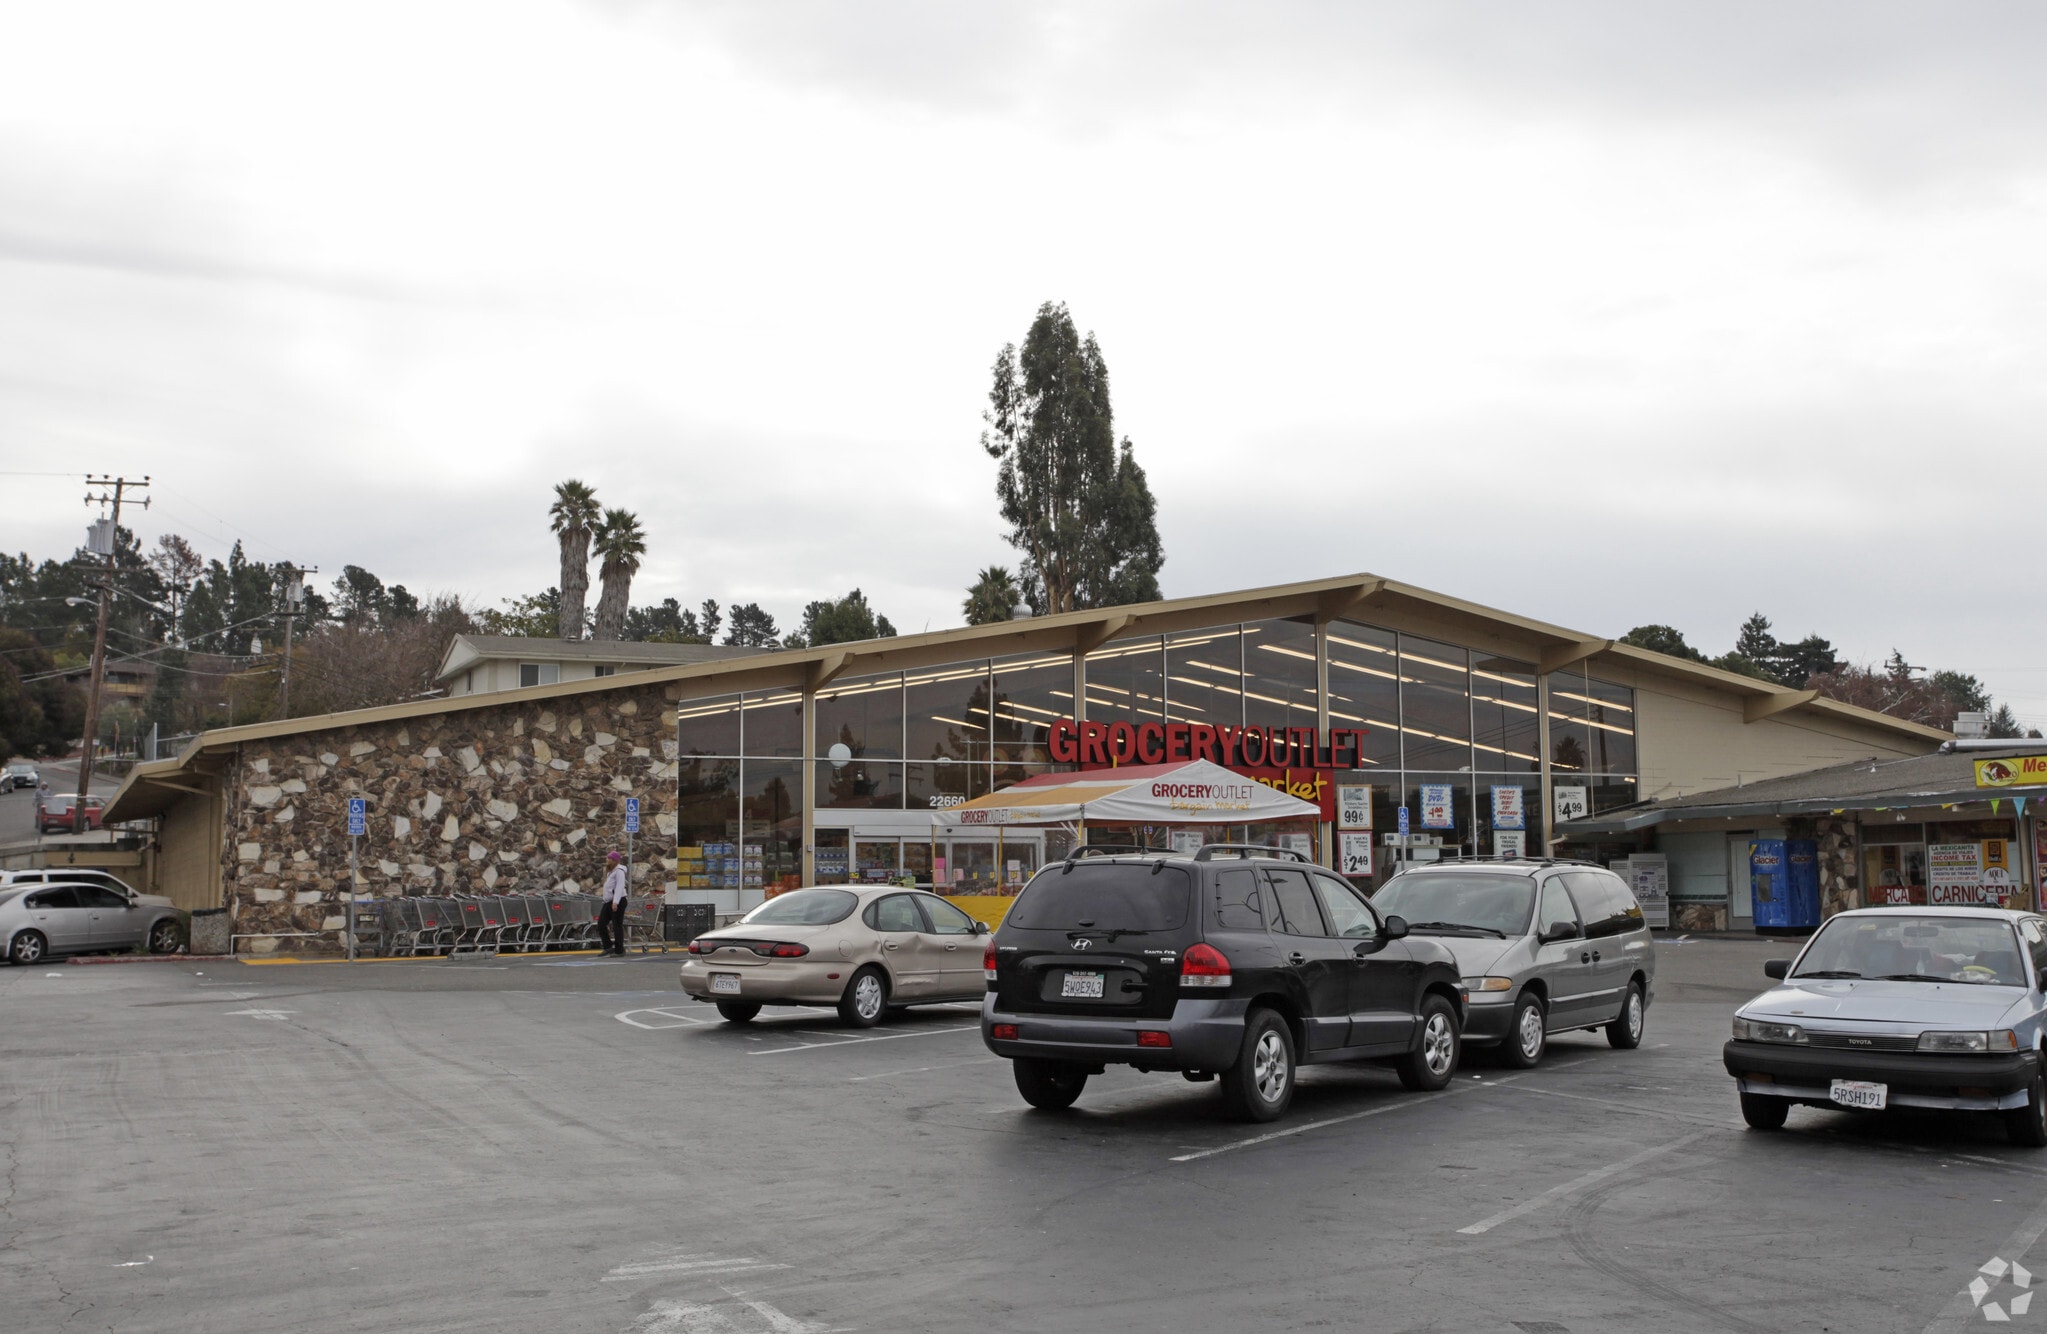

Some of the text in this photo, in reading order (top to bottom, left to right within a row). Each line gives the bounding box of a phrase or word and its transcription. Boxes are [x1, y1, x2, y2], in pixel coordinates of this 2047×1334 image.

[929, 795, 965, 807] 22660
[1170, 796, 1251, 816] bargain market
[1753, 855, 1779, 865] Glacier
[1848, 1038, 1872, 1046] TOYOTA
[1834, 1087, 1881, 1106] 5RSH191
